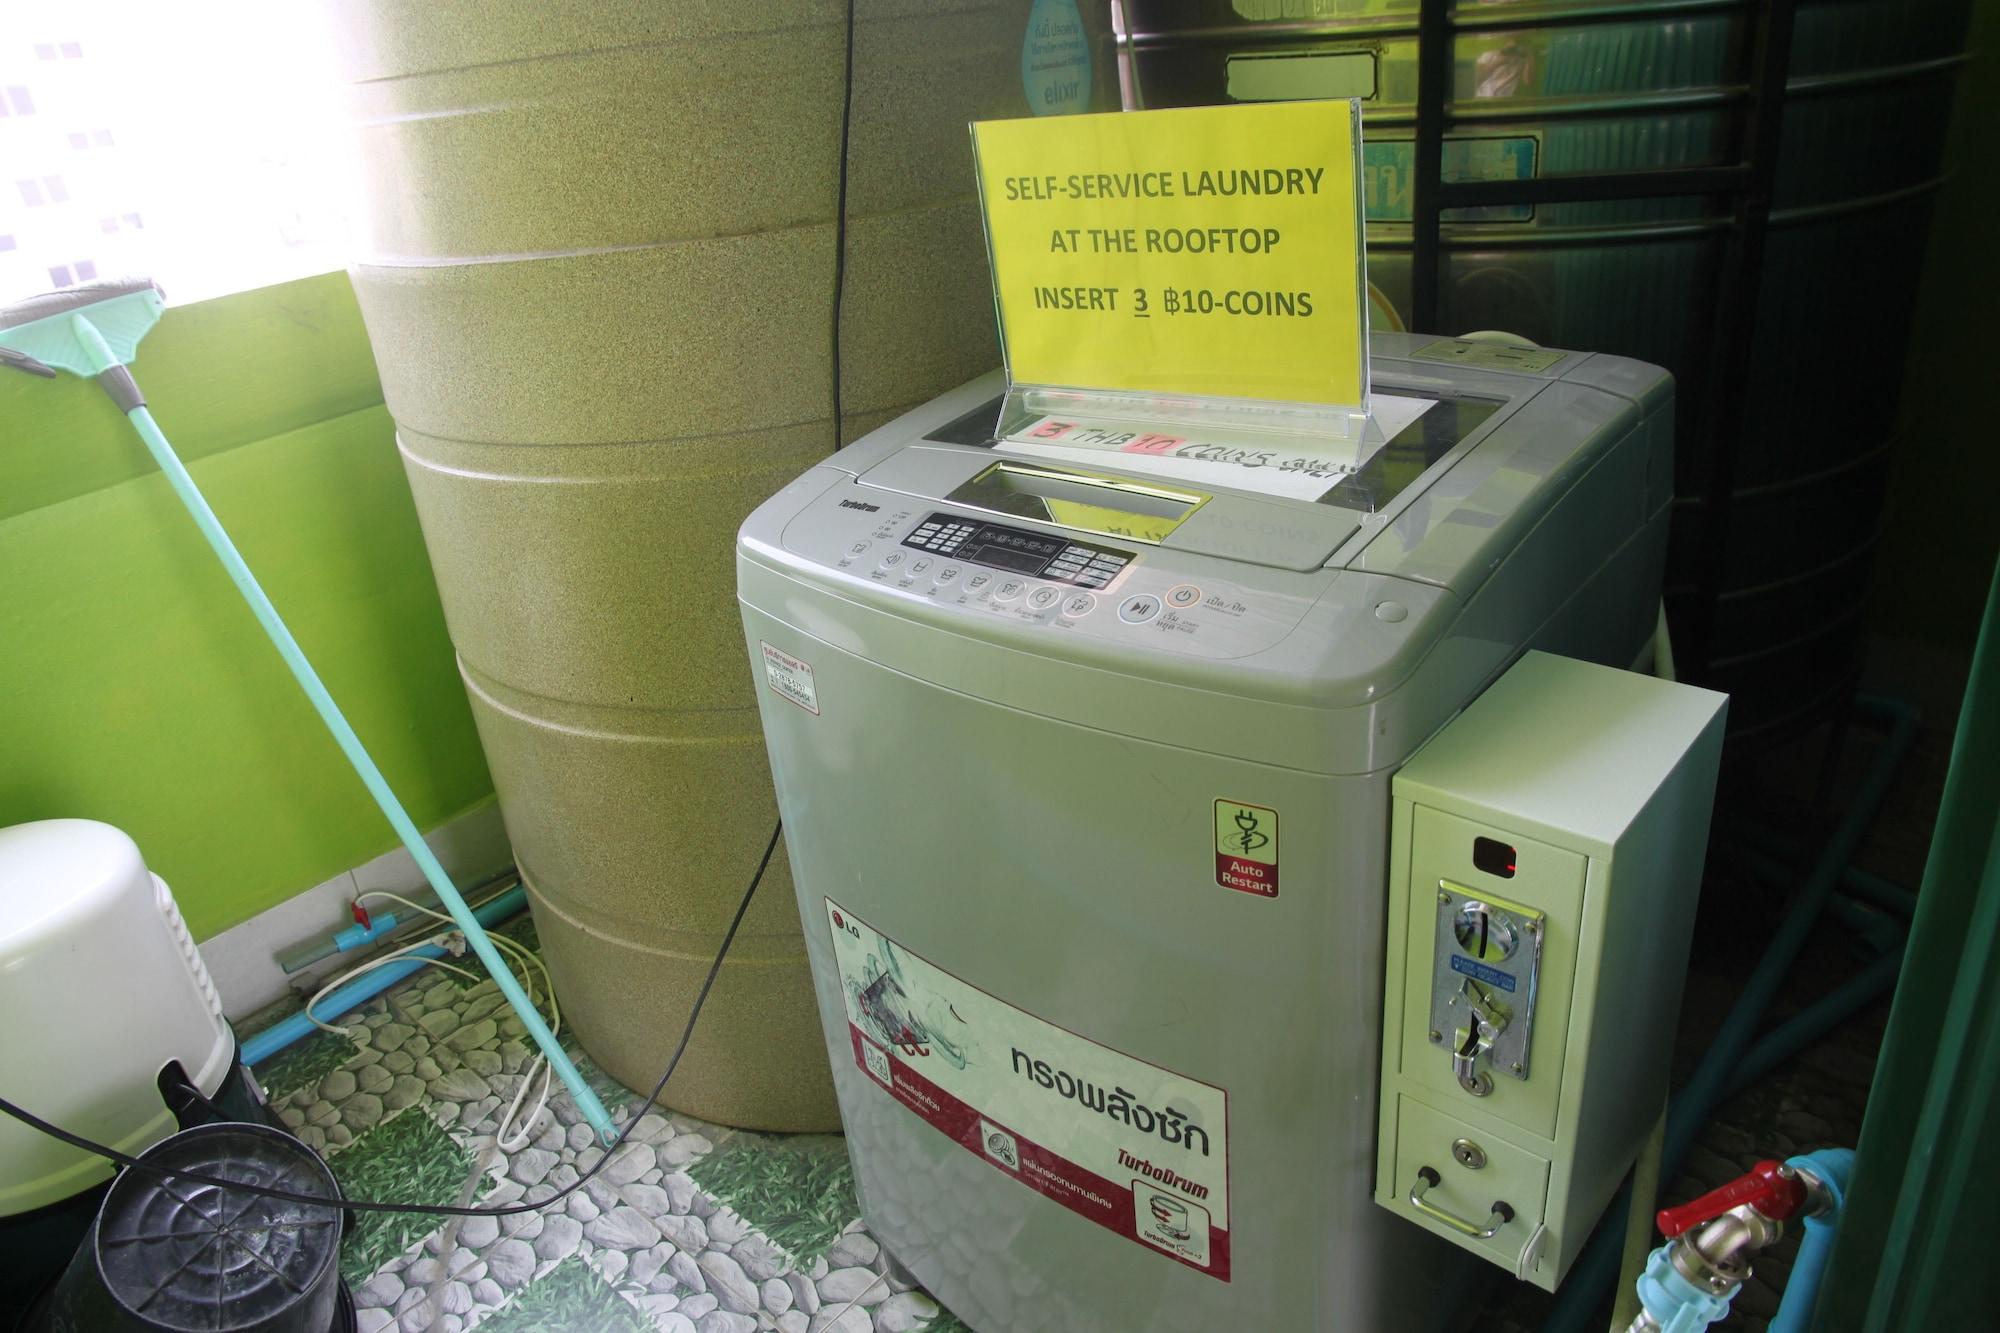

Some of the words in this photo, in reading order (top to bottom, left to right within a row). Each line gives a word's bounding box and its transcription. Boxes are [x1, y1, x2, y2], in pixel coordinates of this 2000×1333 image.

[1005, 171, 1175, 202] SELF-SERVICE
[1183, 168, 1325, 198] LAUNDRY
[1050, 228, 1084, 254] AT
[1088, 228, 1139, 254] THE
[1146, 226, 1281, 255] ROOFTOP
[1034, 285, 1119, 312] INSERT
[1134, 287, 1150, 317] 3
[1033, 422, 1063, 439] 3
[1072, 427, 1136, 447] THB
[1134, 434, 1174, 451] 10
[1176, 443, 1278, 468] COINS
[1222, 870, 1273, 894] Restart
[1230, 860, 1264, 878] Auto
[846, 921, 860, 940] LG
[1011, 1046, 1210, 1157] ทรงพลังซัก
[1117, 1148, 1210, 1200] TurboDrum
